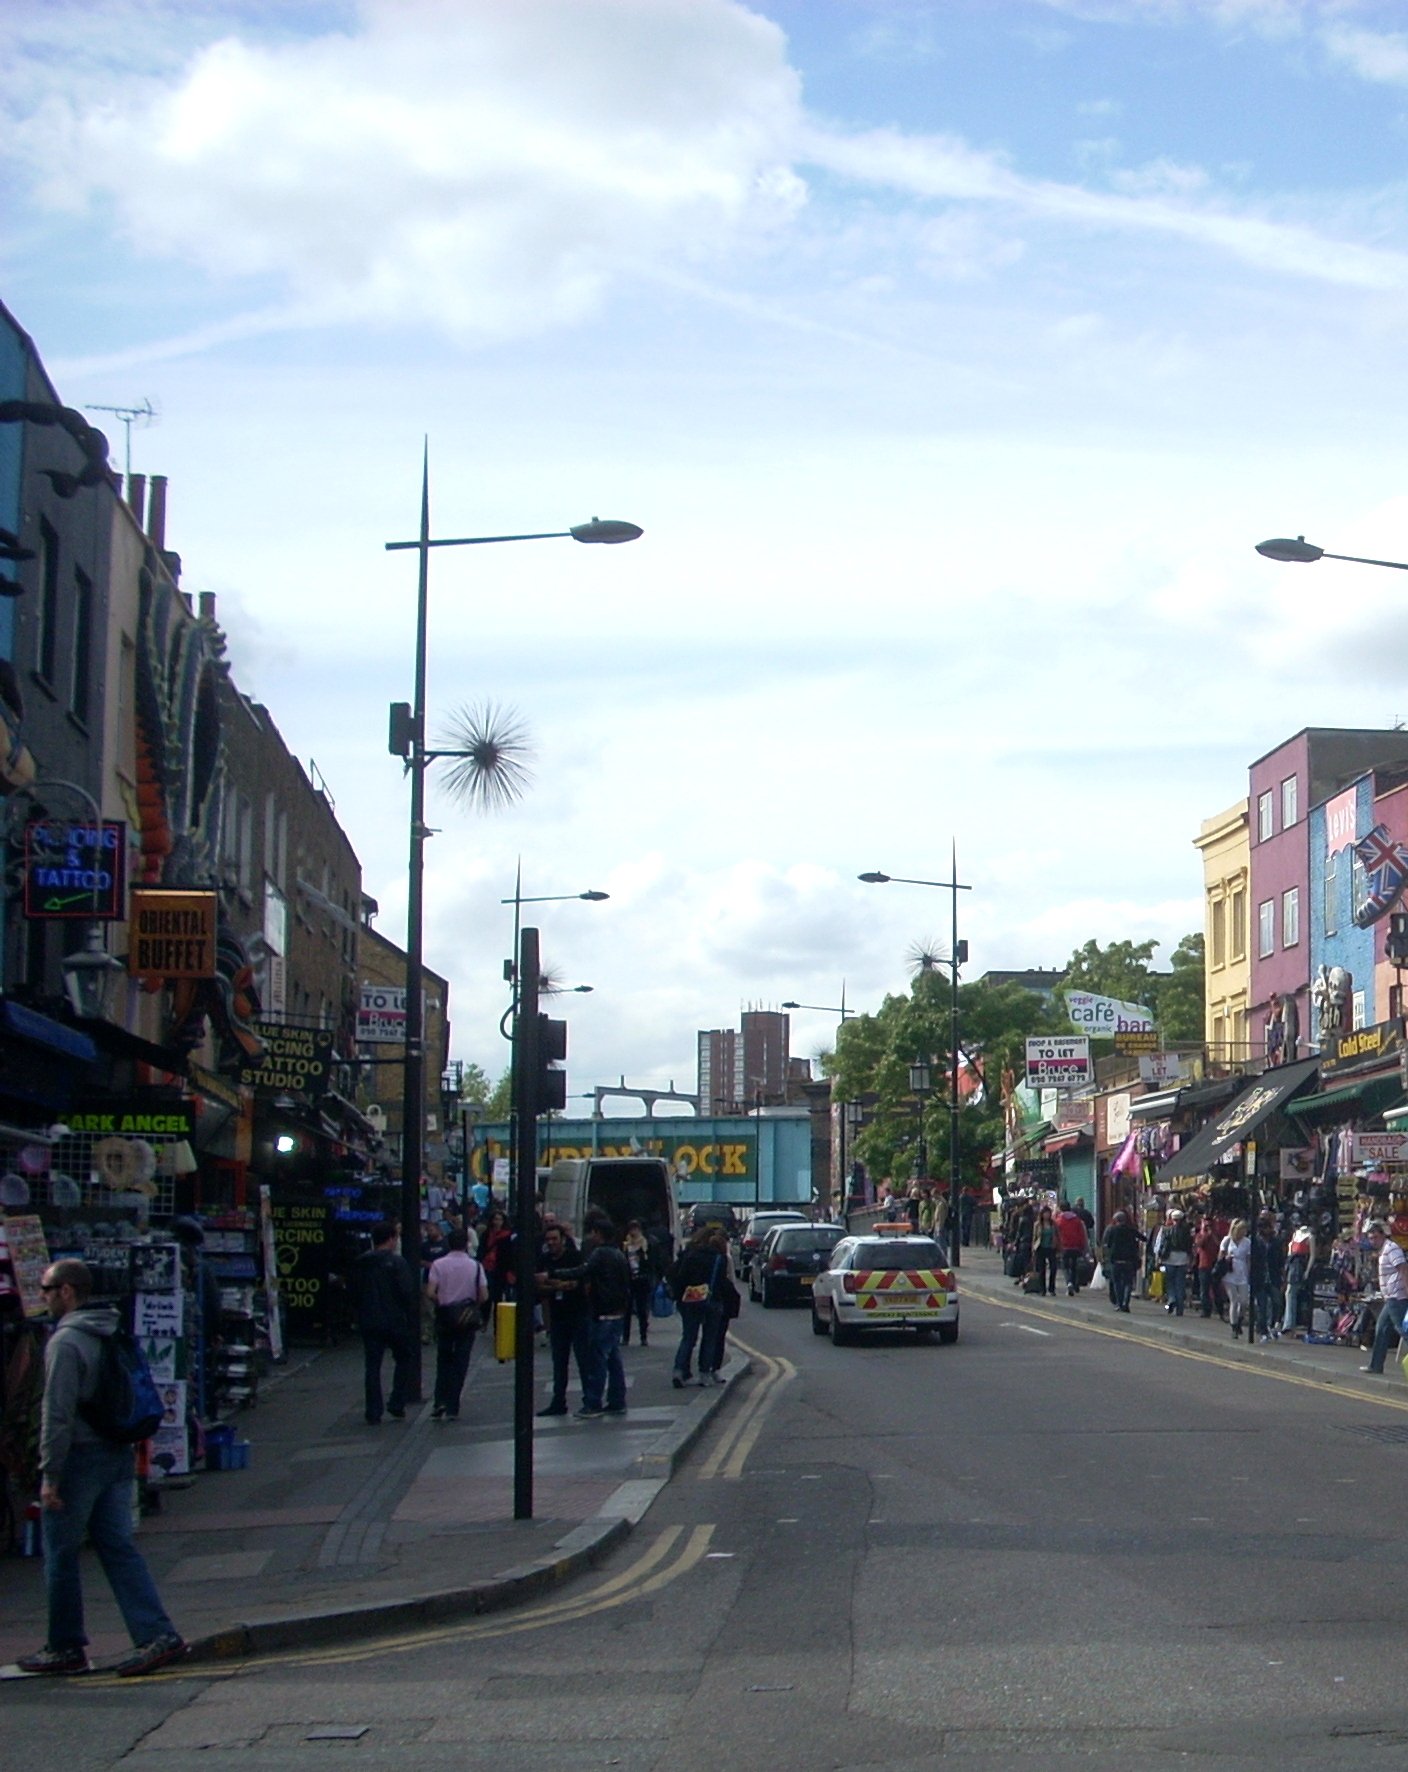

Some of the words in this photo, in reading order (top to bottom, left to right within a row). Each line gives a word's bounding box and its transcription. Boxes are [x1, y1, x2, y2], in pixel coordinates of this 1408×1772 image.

[138, 909, 207, 935] ORIENTAL
[138, 938, 207, 970] BUFFET
[363, 994, 387, 1008] TO
[394, 996, 408, 1009] LE
[369, 1012, 407, 1029] Bruc
[1072, 1003, 1114, 1022] café
[1084, 1025, 1112, 1035] organic
[1117, 1015, 1150, 1032] bar
[252, 1024, 279, 1038] LUE
[282, 1028, 314, 1042] SKIN
[1116, 1033, 1157, 1041] BUREAU
[1038, 1049, 1054, 1058] TO
[1058, 1048, 1075, 1058] LET
[261, 1055, 323, 1075] ATTOO
[1038, 1061, 1078, 1076] Bruce
[241, 1069, 304, 1089] STUDIO
[121, 1114, 189, 1132] ANGEL
[1368, 1147, 1399, 1159] SALE
[290, 1206, 326, 1219] SKIN
[275, 1229, 326, 1243] RCING
[288, 1293, 315, 1308] DIO
